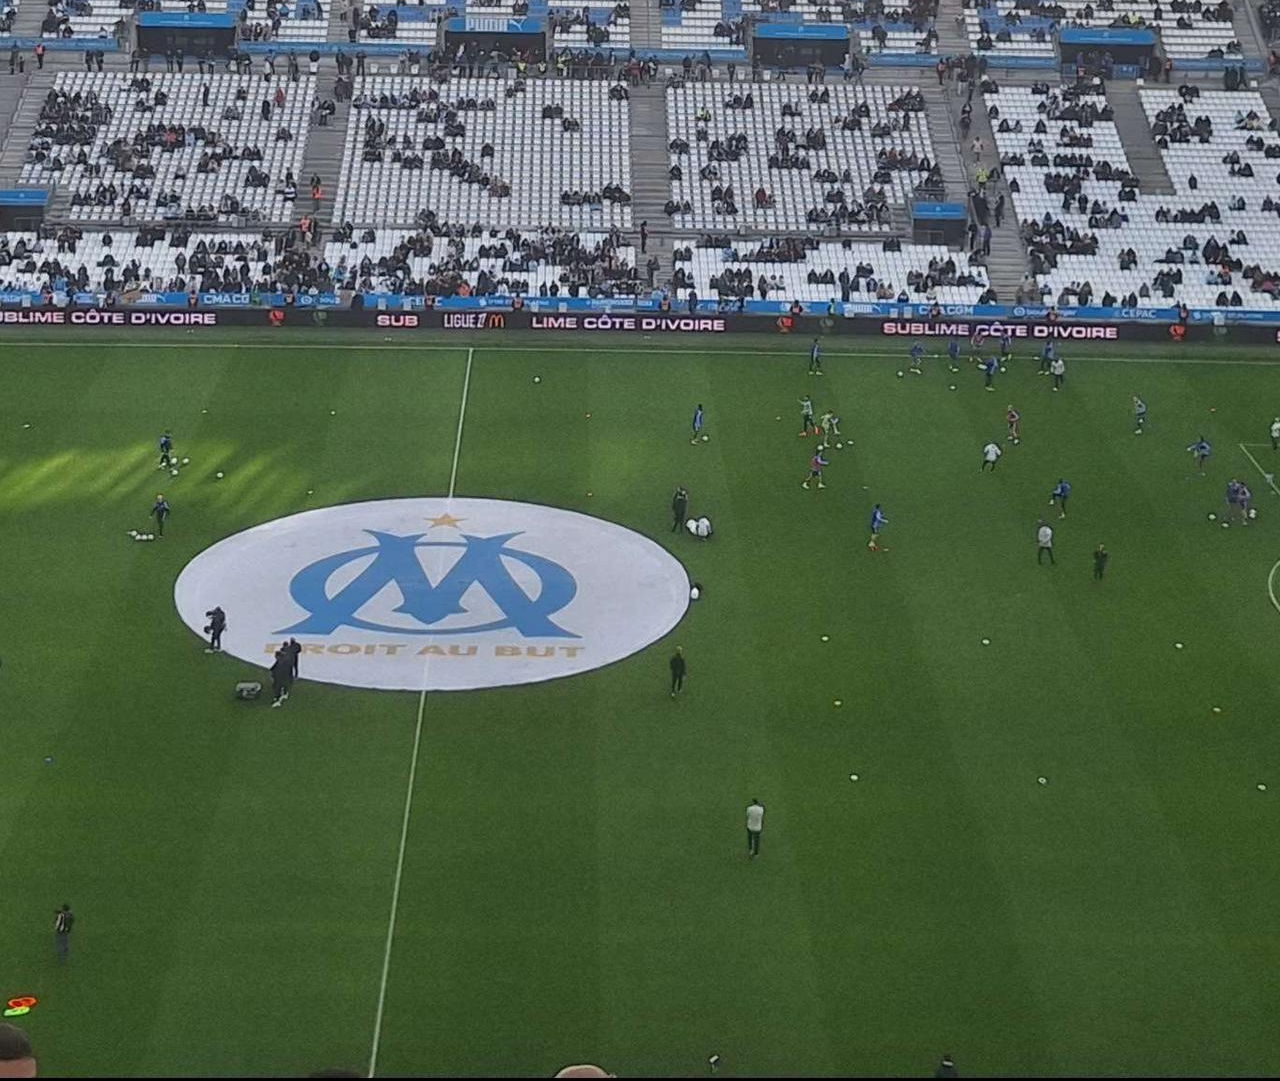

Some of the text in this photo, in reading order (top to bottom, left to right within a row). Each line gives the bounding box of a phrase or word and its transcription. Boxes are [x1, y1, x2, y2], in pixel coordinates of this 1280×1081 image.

[465, 17, 508, 32] PUMA
[229, 295, 250, 304] CG
[70, 309, 124, 324] CÔTE
[131, 313, 217, 325] D'IVOIRE
[947, 306, 974, 315] CGM
[1121, 308, 1157, 318] CEPAC
[377, 314, 418, 327] SUB
[443, 314, 474, 328] LIGUE
[532, 314, 725, 331] LIME CÔTE D'IVOIRE
[883, 321, 1118, 339] SUBLIME CÔTE D'IVOIRE
[416, 644, 478, 656] AU
[494, 645, 586, 658] BUT
